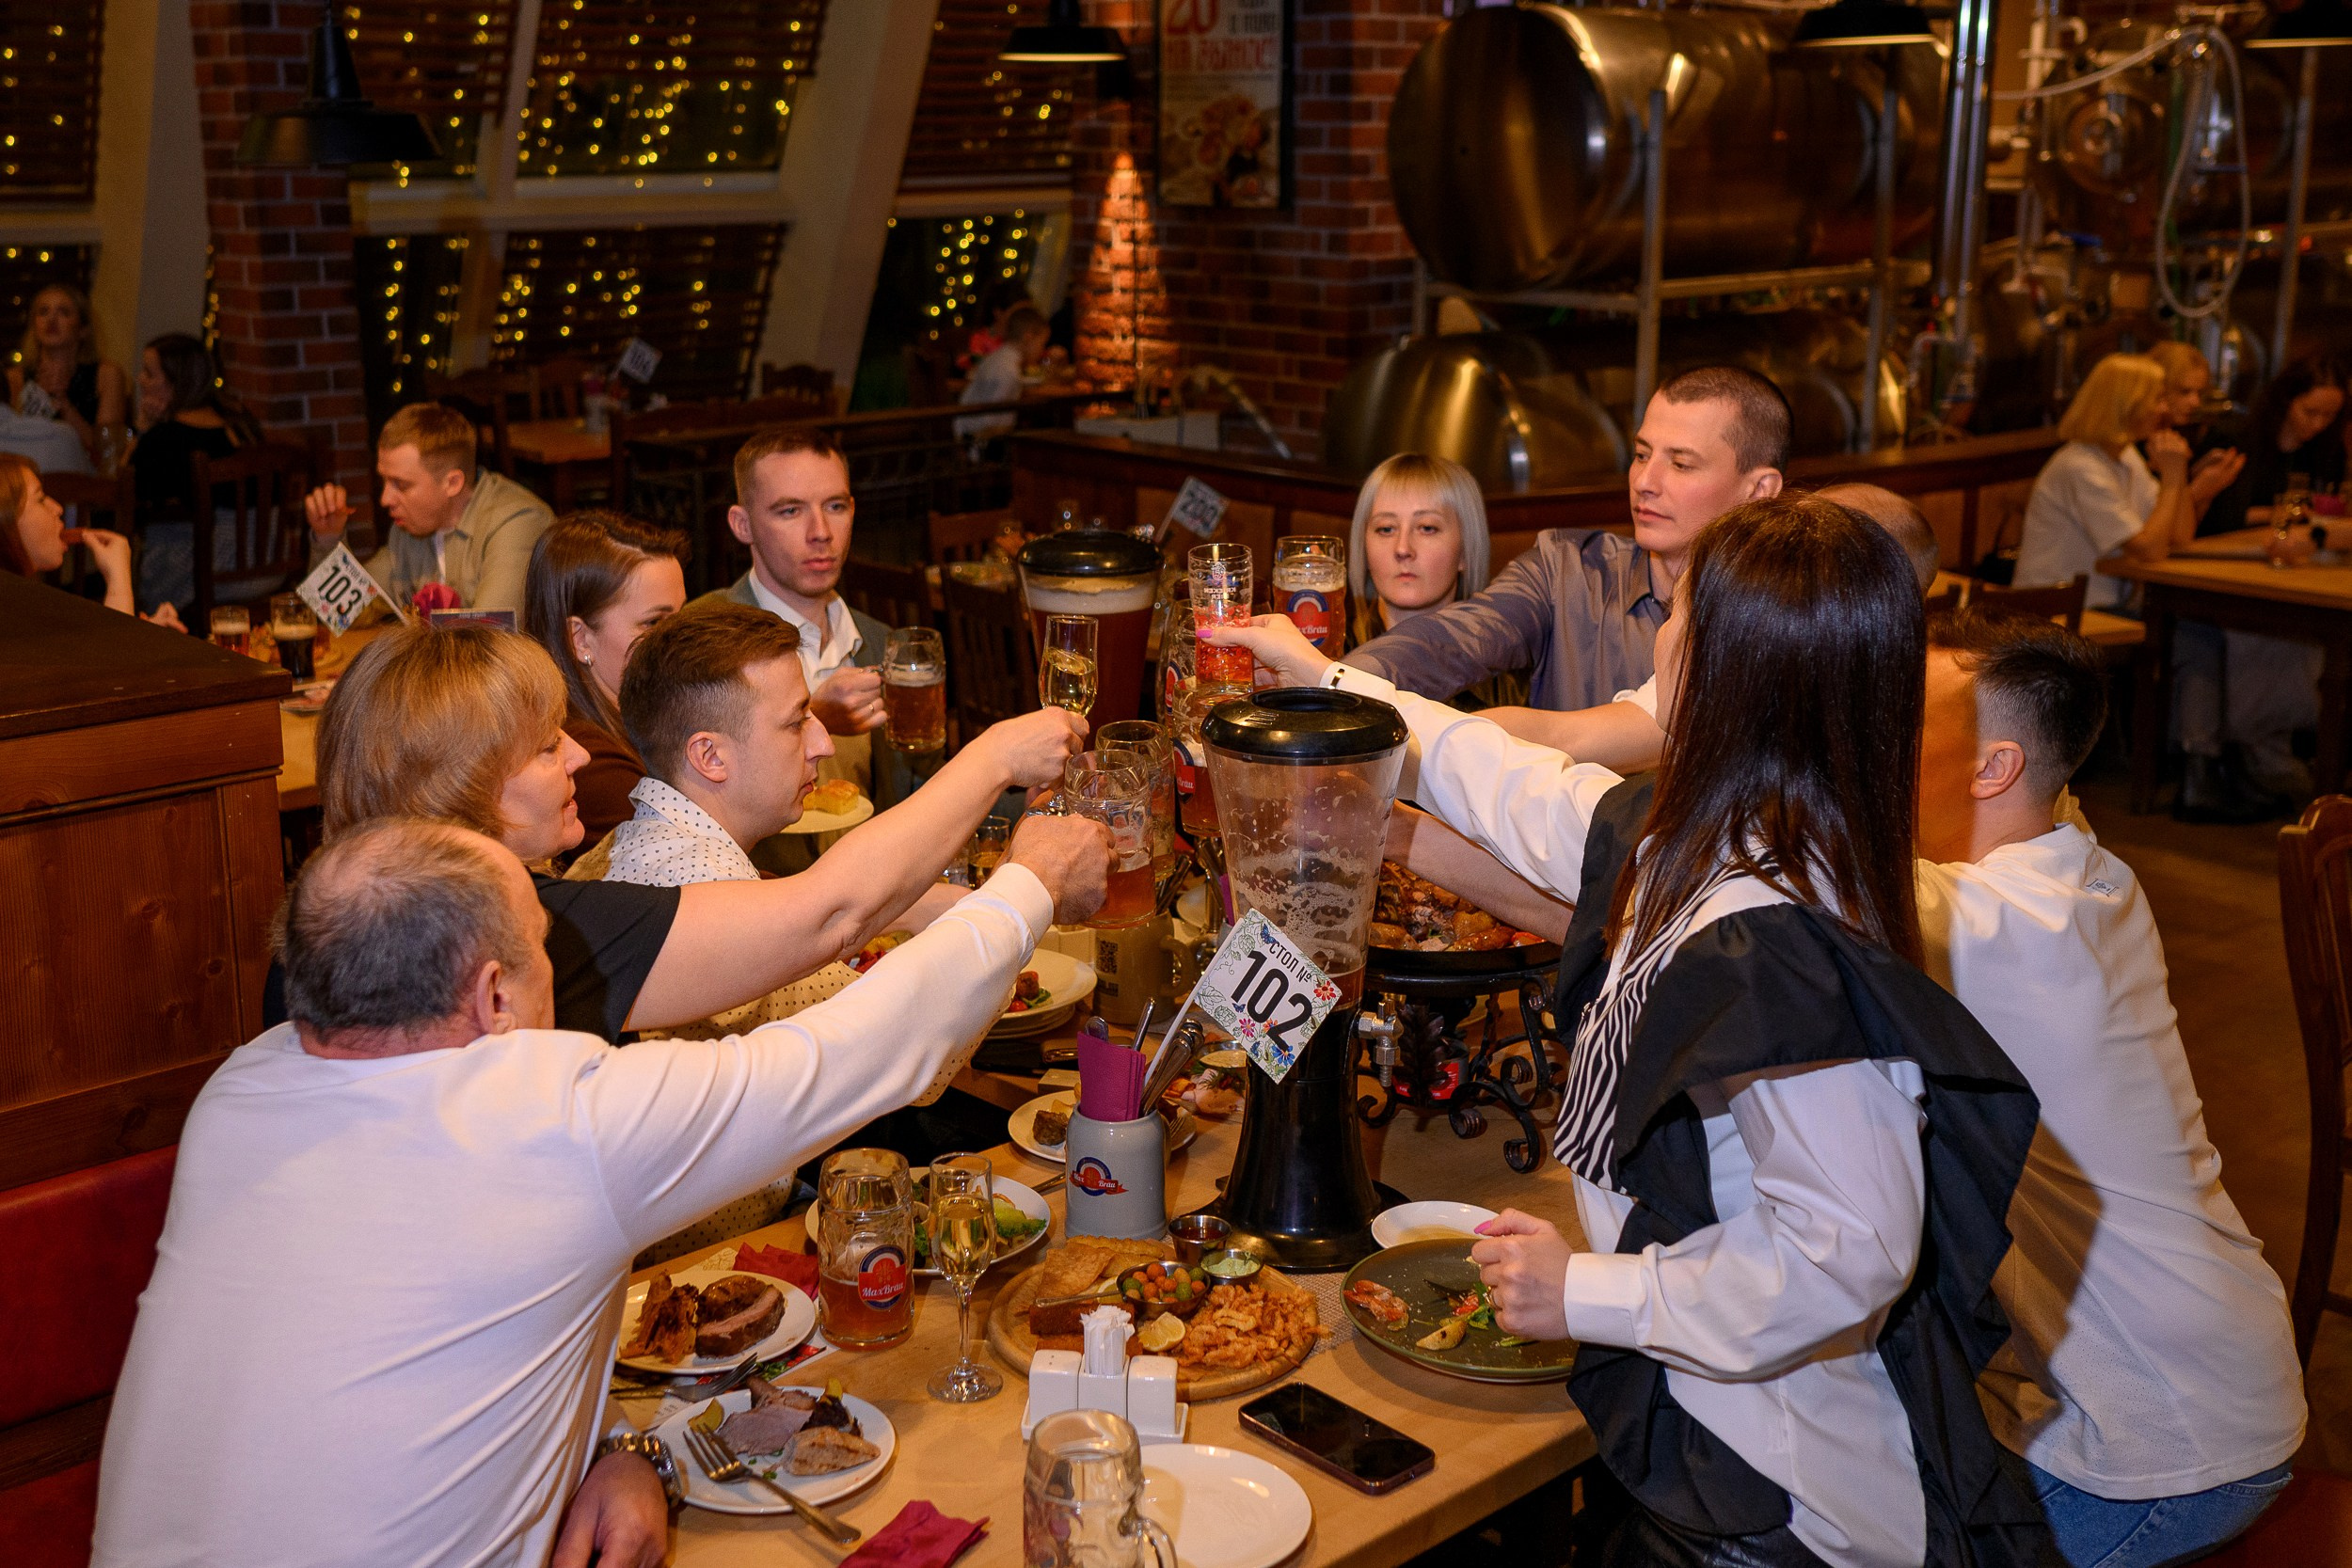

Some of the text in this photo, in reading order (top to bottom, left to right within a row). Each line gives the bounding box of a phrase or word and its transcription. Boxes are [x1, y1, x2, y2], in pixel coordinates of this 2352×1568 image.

[318, 565, 362, 615] 103
[1268, 942, 1311, 983] СТОЛ №
[1231, 950, 1312, 1052] 102
